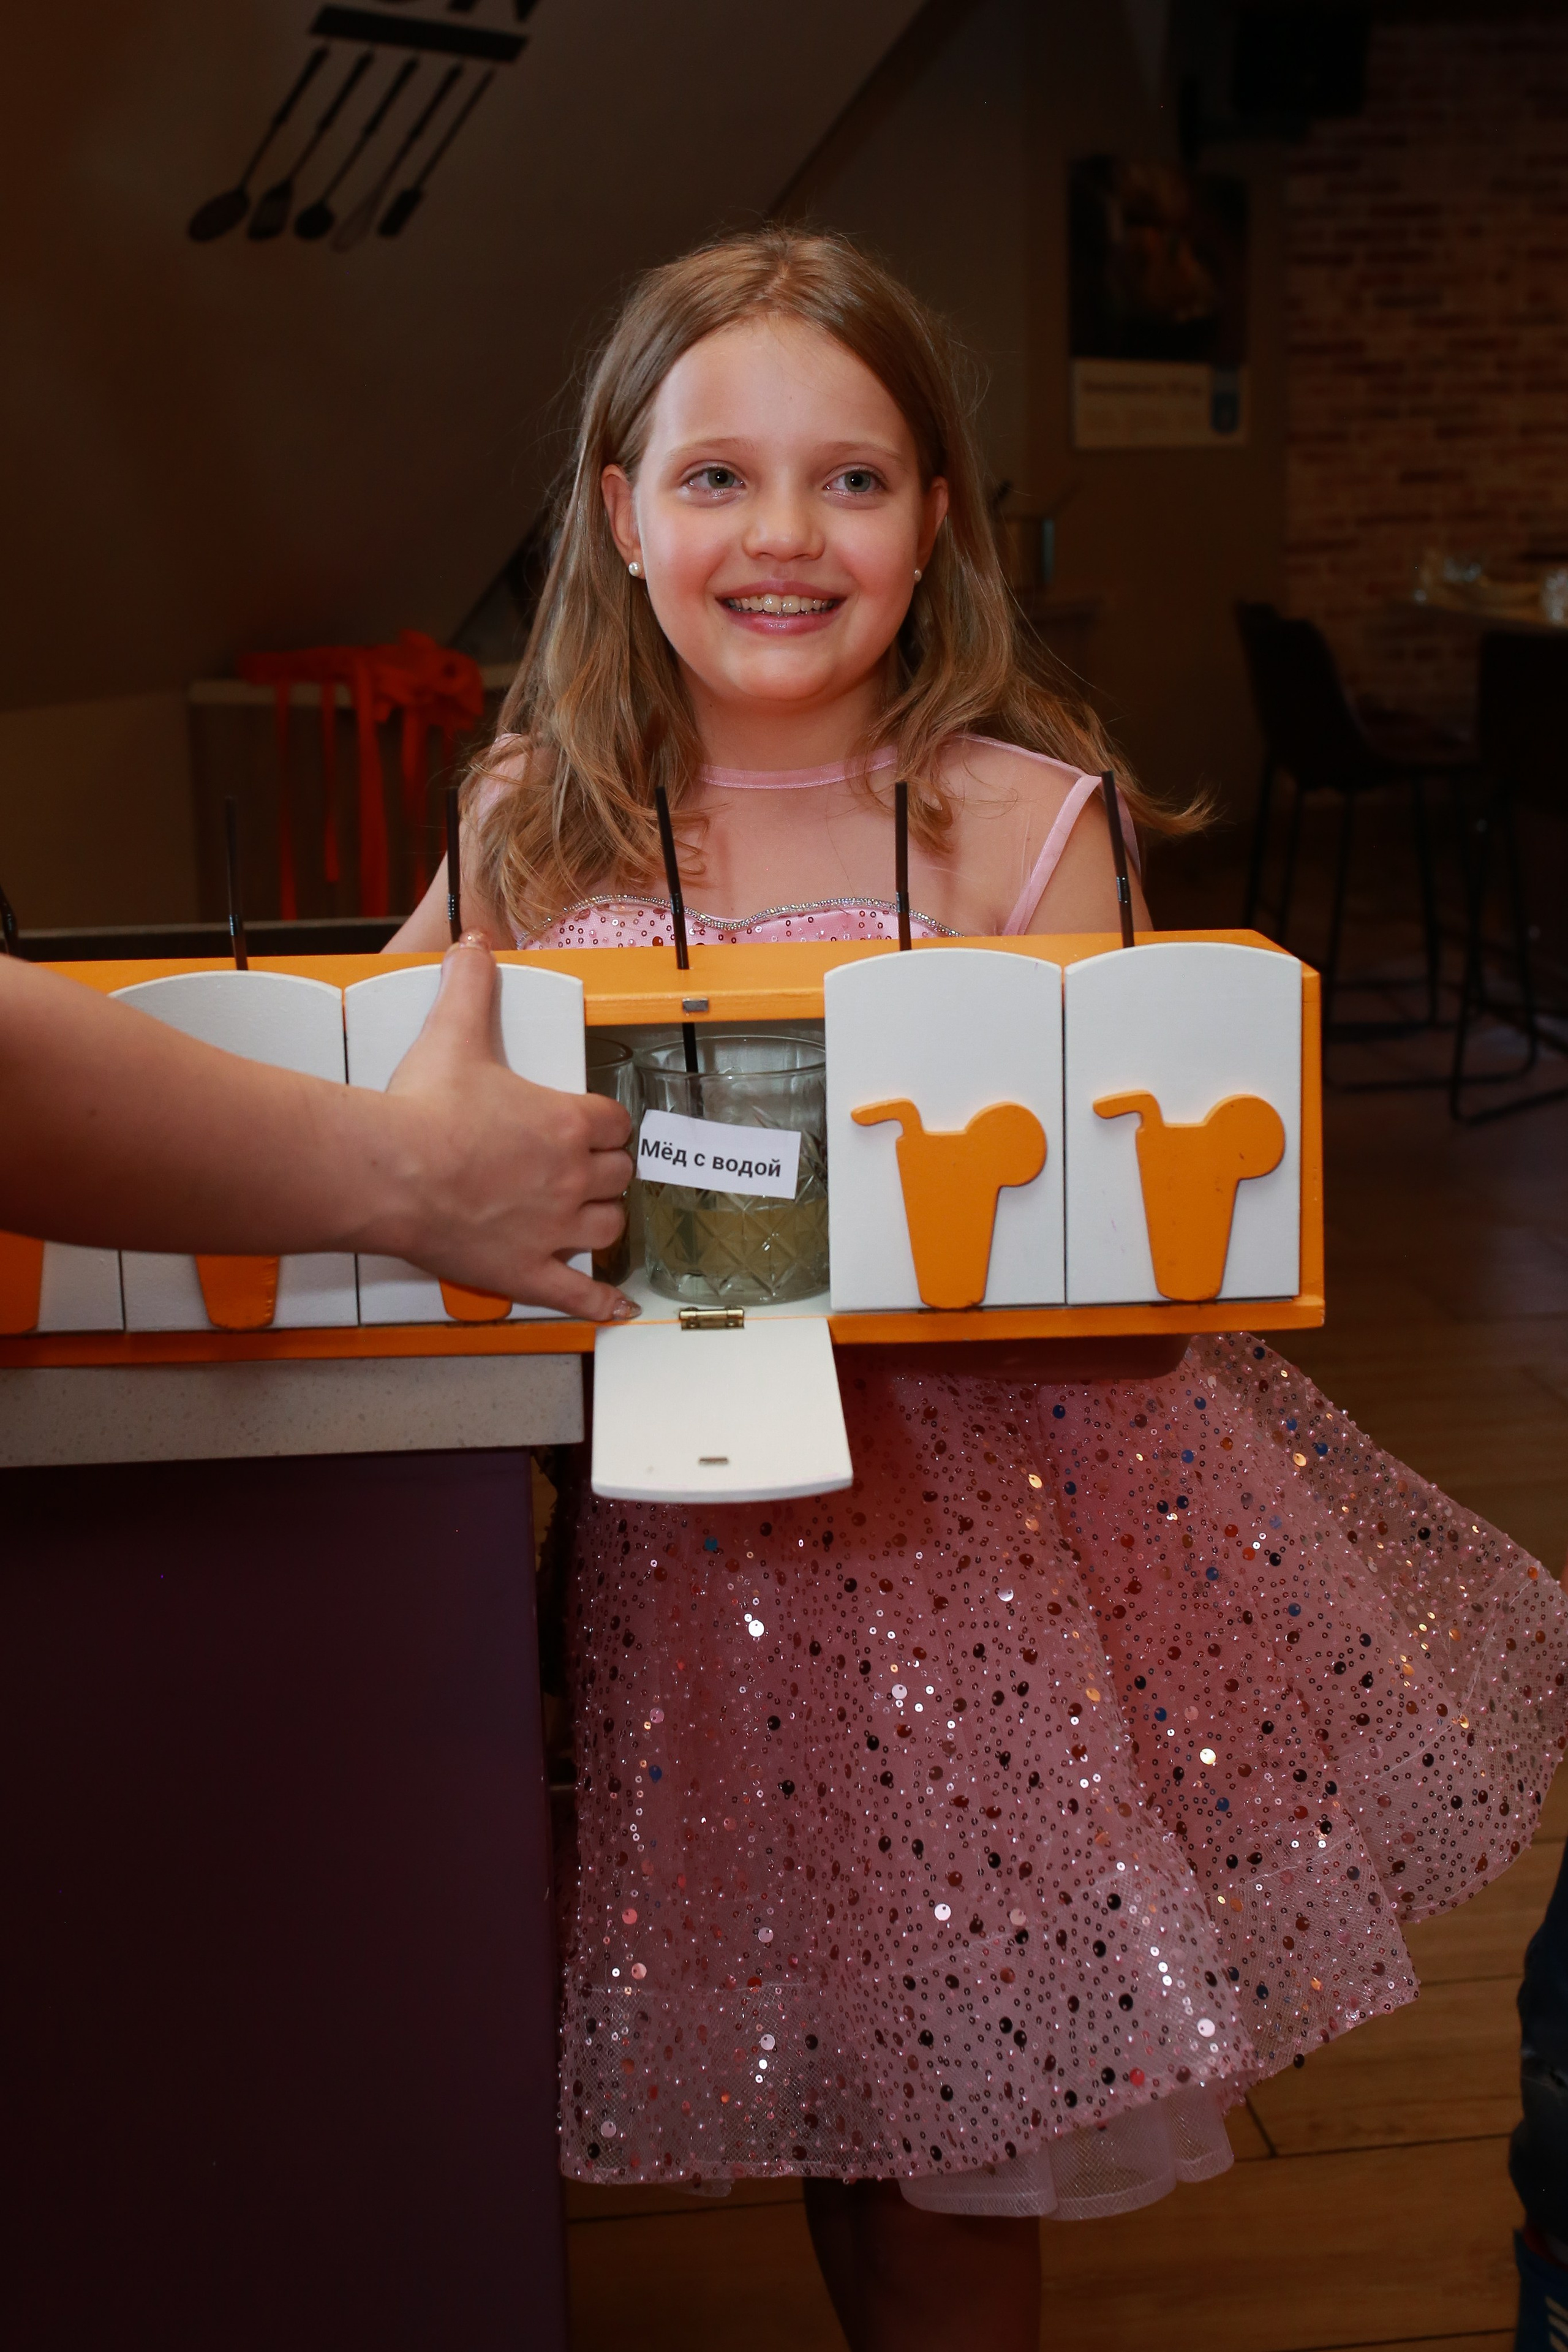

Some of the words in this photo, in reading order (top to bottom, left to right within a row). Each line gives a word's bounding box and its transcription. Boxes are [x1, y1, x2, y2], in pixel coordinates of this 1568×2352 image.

[641, 1138, 687, 1167] Мёд
[693, 1152, 706, 1166] с
[712, 1156, 781, 1178] водой
